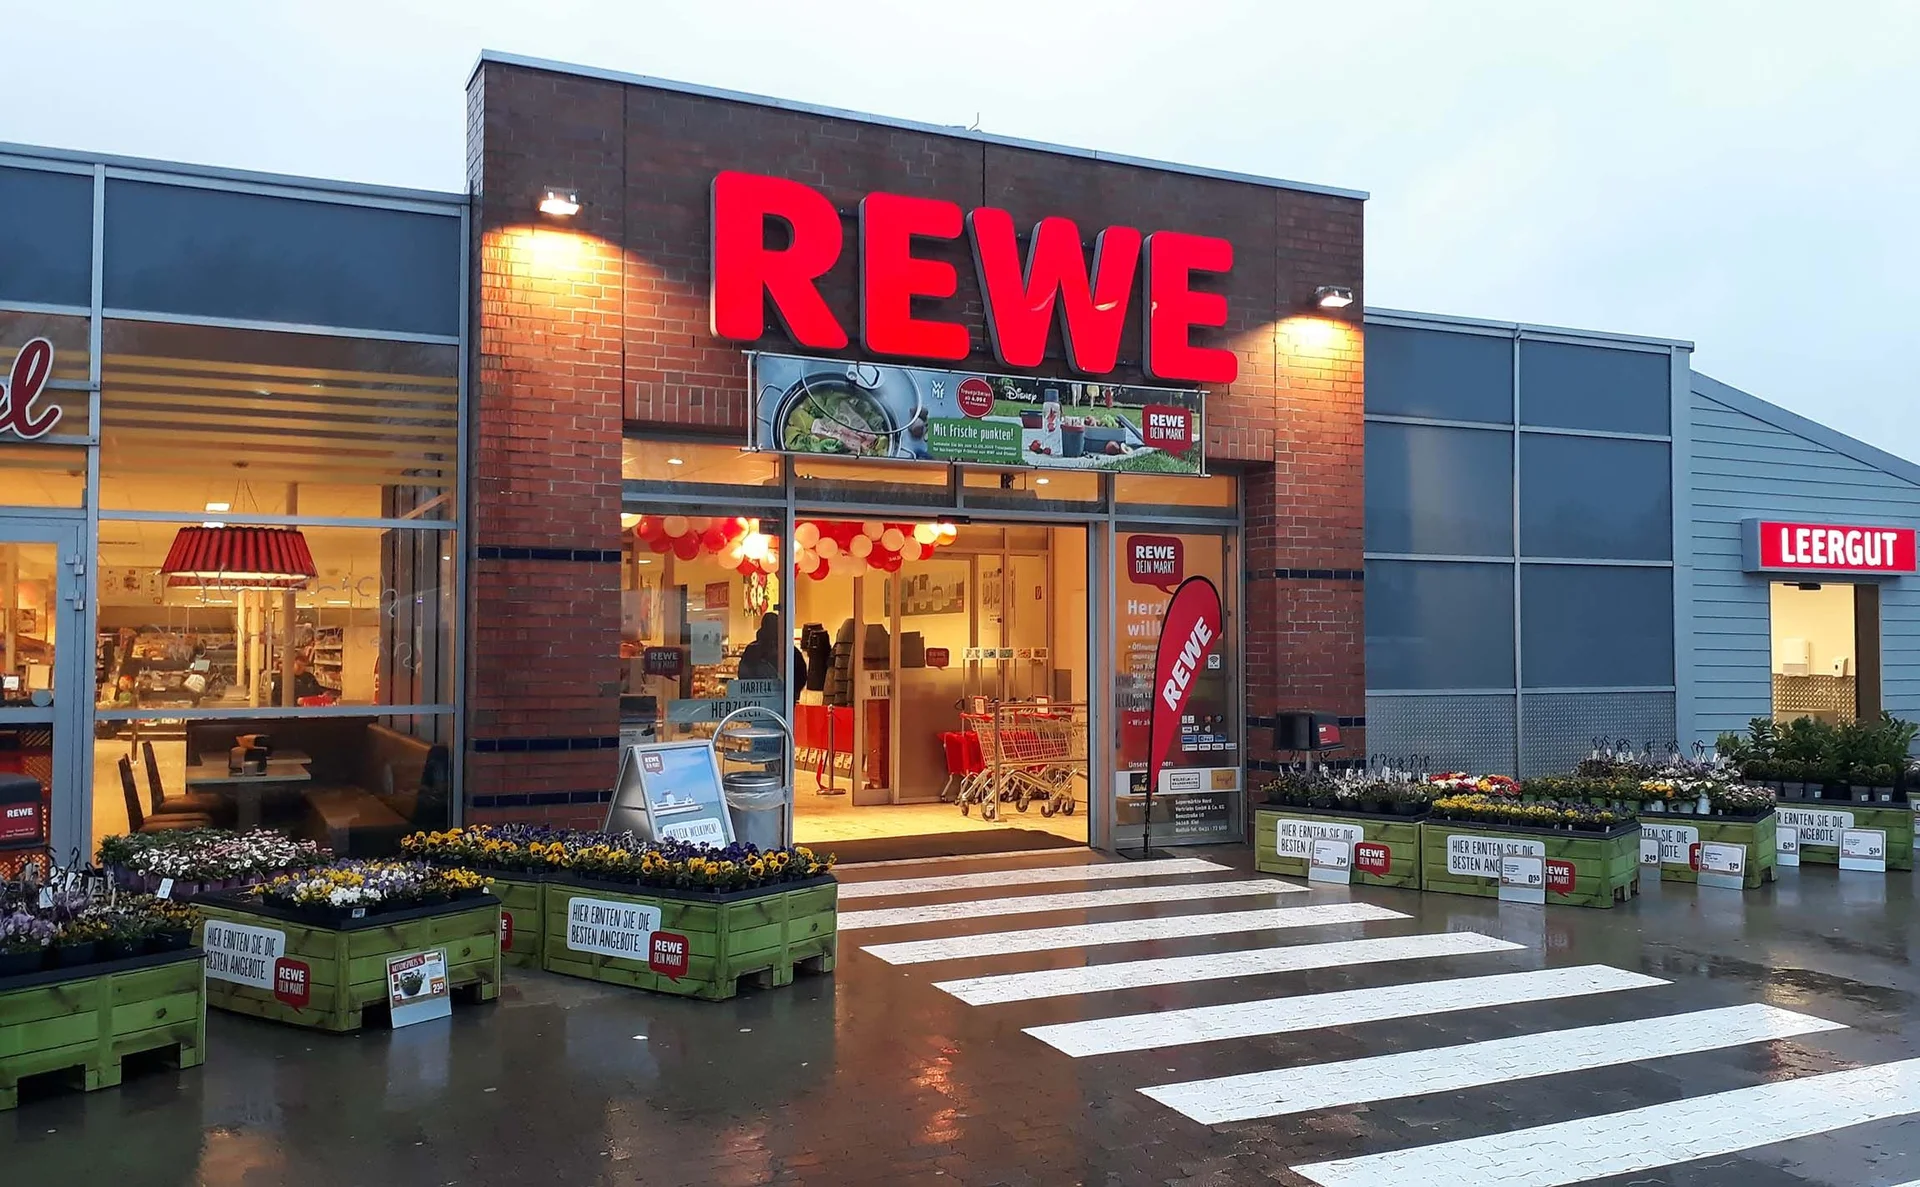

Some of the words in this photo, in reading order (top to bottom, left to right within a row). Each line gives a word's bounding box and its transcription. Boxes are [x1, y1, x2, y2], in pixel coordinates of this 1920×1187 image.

[711, 170, 1237, 383] REWE
[1004, 386, 1037, 404] Disney
[1150, 414, 1185, 427] REWE
[933, 423, 946, 436] Mit
[949, 425, 977, 439] Frische
[980, 428, 1014, 442] punkten!
[1150, 427, 1164, 439] DEIN
[1166, 428, 1184, 440] MARKT
[1136, 546, 1175, 559] REWE
[1781, 527, 1897, 566] LEERGUT
[1136, 560, 1151, 573] DEIN
[1154, 561, 1174, 574] MARKT
[651, 652, 677, 660] REWE
[1162, 617, 1213, 711] REWE
[7, 808, 33, 818] REWE
[1784, 813, 1814, 826] ERNTEN
[1817, 815, 1828, 827] SIE
[1833, 816, 1843, 828] DIE
[1282, 823, 1297, 837] HIER
[1300, 825, 1327, 838] ERNTEN
[1661, 830, 1673, 843] SIE
[1676, 831, 1688, 844] DIE
[1800, 829, 1834, 841] NGEBOTE
[1281, 838, 1306, 853] BESTEN
[1359, 848, 1385, 858] REWE
[1452, 840, 1469, 854] HIER
[1472, 842, 1504, 856] ERNTEN
[1506, 843, 1518, 855] SIE
[1522, 845, 1534, 856] DIE
[1359, 857, 1370, 866] DEIN
[1371, 858, 1385, 867] MARKT
[1452, 855, 1480, 870] BESTEN
[572, 904, 588, 922] HIER
[590, 906, 620, 927] ERNTEN
[623, 911, 635, 930] SIE
[638, 913, 651, 932] DIE
[207, 927, 222, 947] HIER
[223, 929, 250, 953] ERNTEN
[251, 934, 263, 955] SIE
[264, 937, 276, 957] DIE
[571, 925, 597, 946] BESTEN
[599, 929, 641, 952] ANGEBOTE.
[655, 940, 683, 954] REWE
[206, 949, 228, 972] BESTEN
[230, 955, 267, 980] ANGEBOTE.
[654, 953, 665, 964] DEIN
[666, 954, 682, 966] MARKT
[279, 967, 305, 982] REWE
[278, 980, 289, 993] DEIN
[289, 980, 304, 996] MARKT
